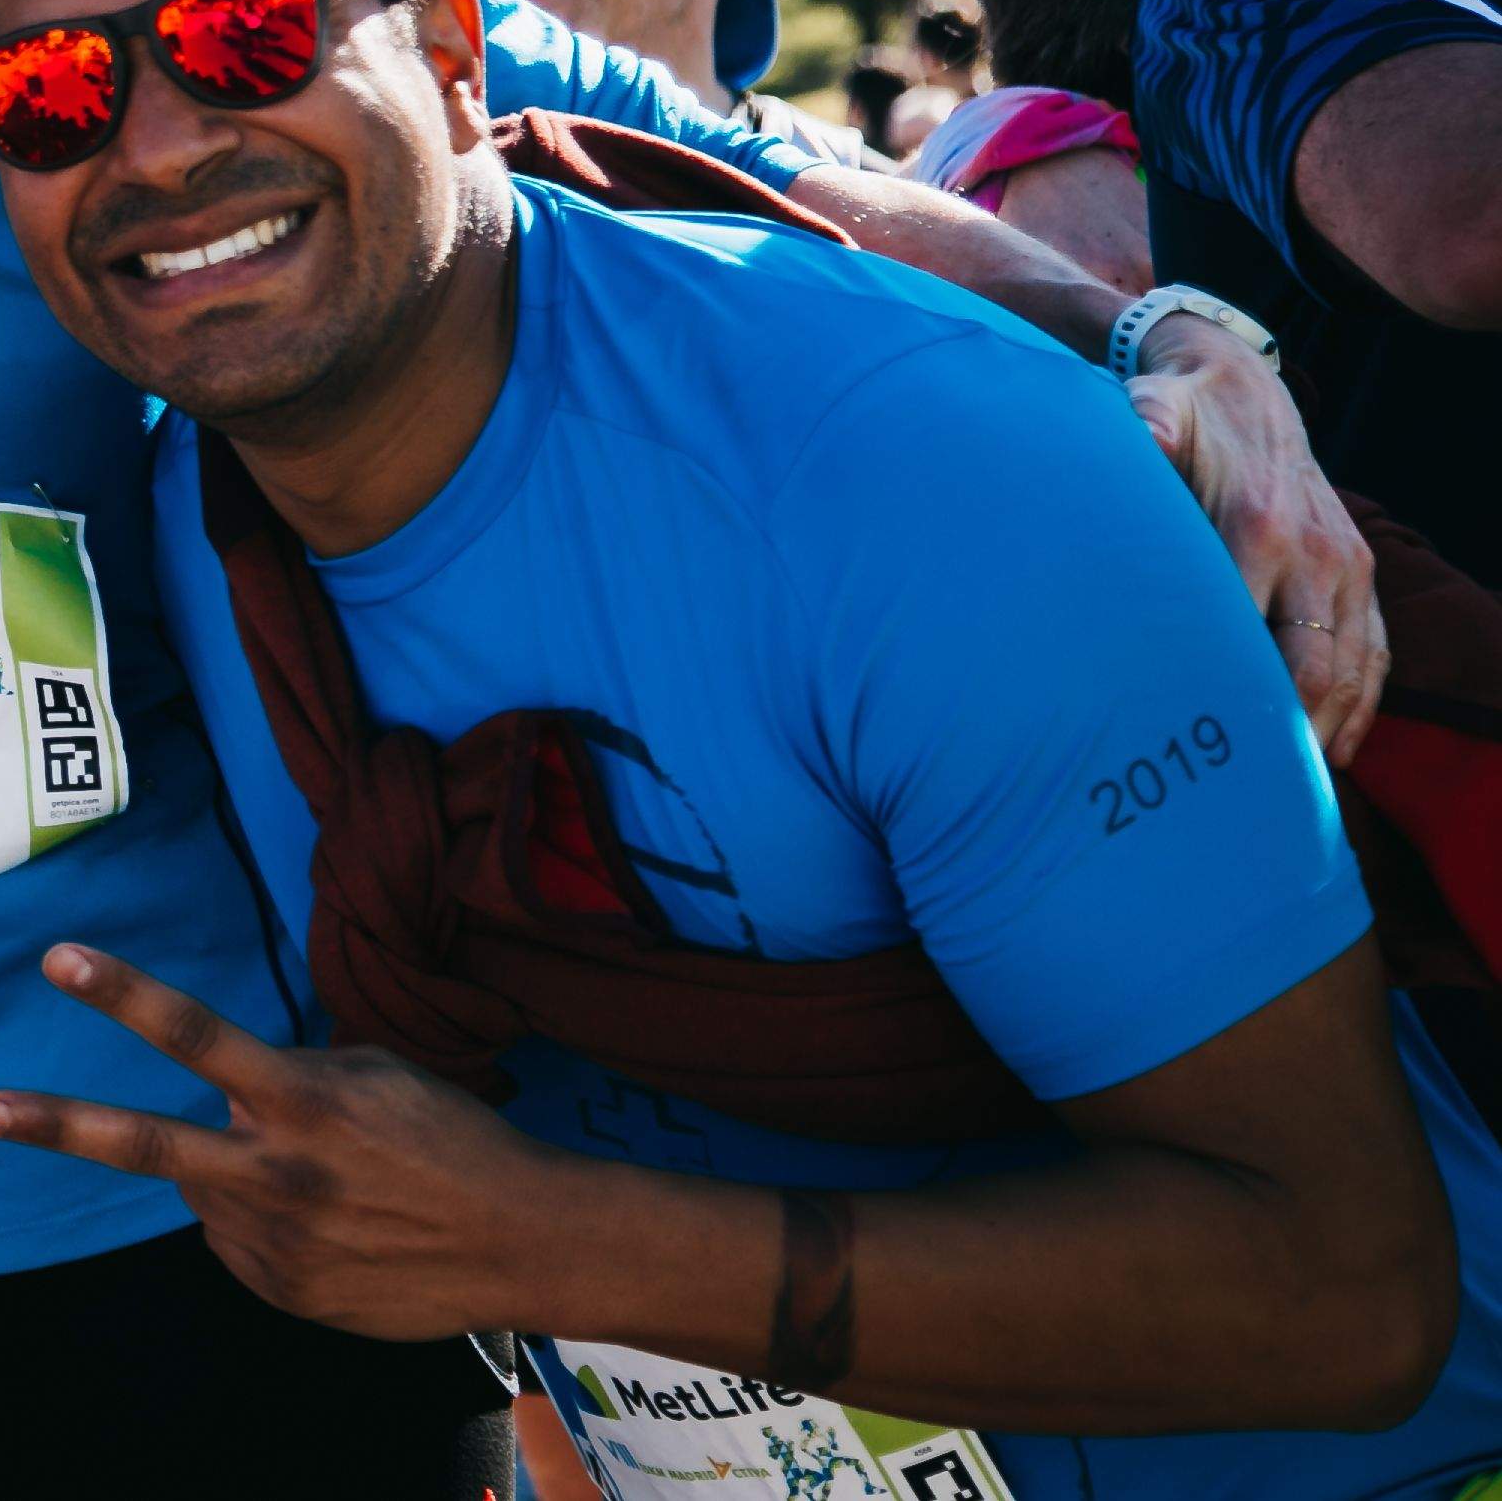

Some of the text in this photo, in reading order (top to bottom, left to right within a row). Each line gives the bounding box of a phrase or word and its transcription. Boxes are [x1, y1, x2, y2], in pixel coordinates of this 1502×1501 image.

[1088, 714, 1232, 836] 2019
[611, 1376, 806, 1422] MetLife
[668, 1469, 717, 1480] MADRID
